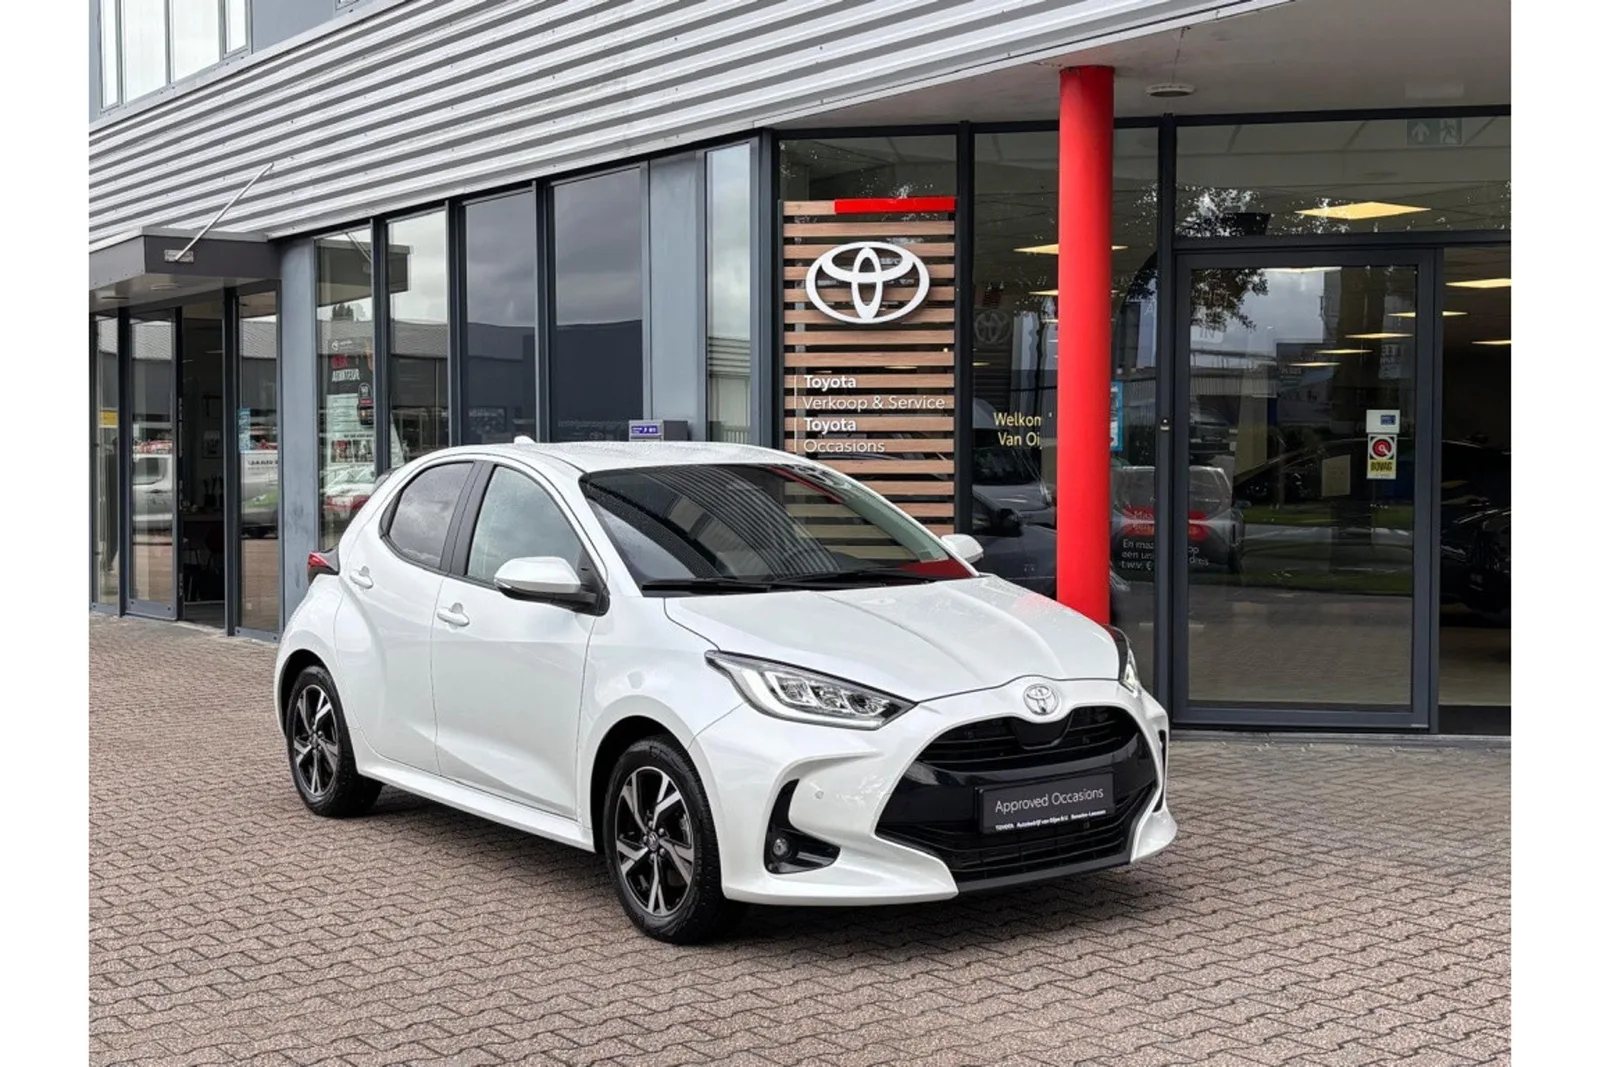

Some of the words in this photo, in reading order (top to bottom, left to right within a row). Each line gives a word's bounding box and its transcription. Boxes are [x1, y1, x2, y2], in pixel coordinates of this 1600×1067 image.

[803, 374, 857, 392] Toyota
[802, 395, 868, 413] Verkoop
[872, 395, 884, 410] &
[888, 395, 946, 410] Service
[803, 417, 857, 435] Toyota
[803, 438, 886, 453] Occasions
[997, 431, 1022, 447] Van
[1025, 431, 1043, 450] Oi
[994, 793, 1049, 815] Approved
[1051, 788, 1104, 805] Occasions
